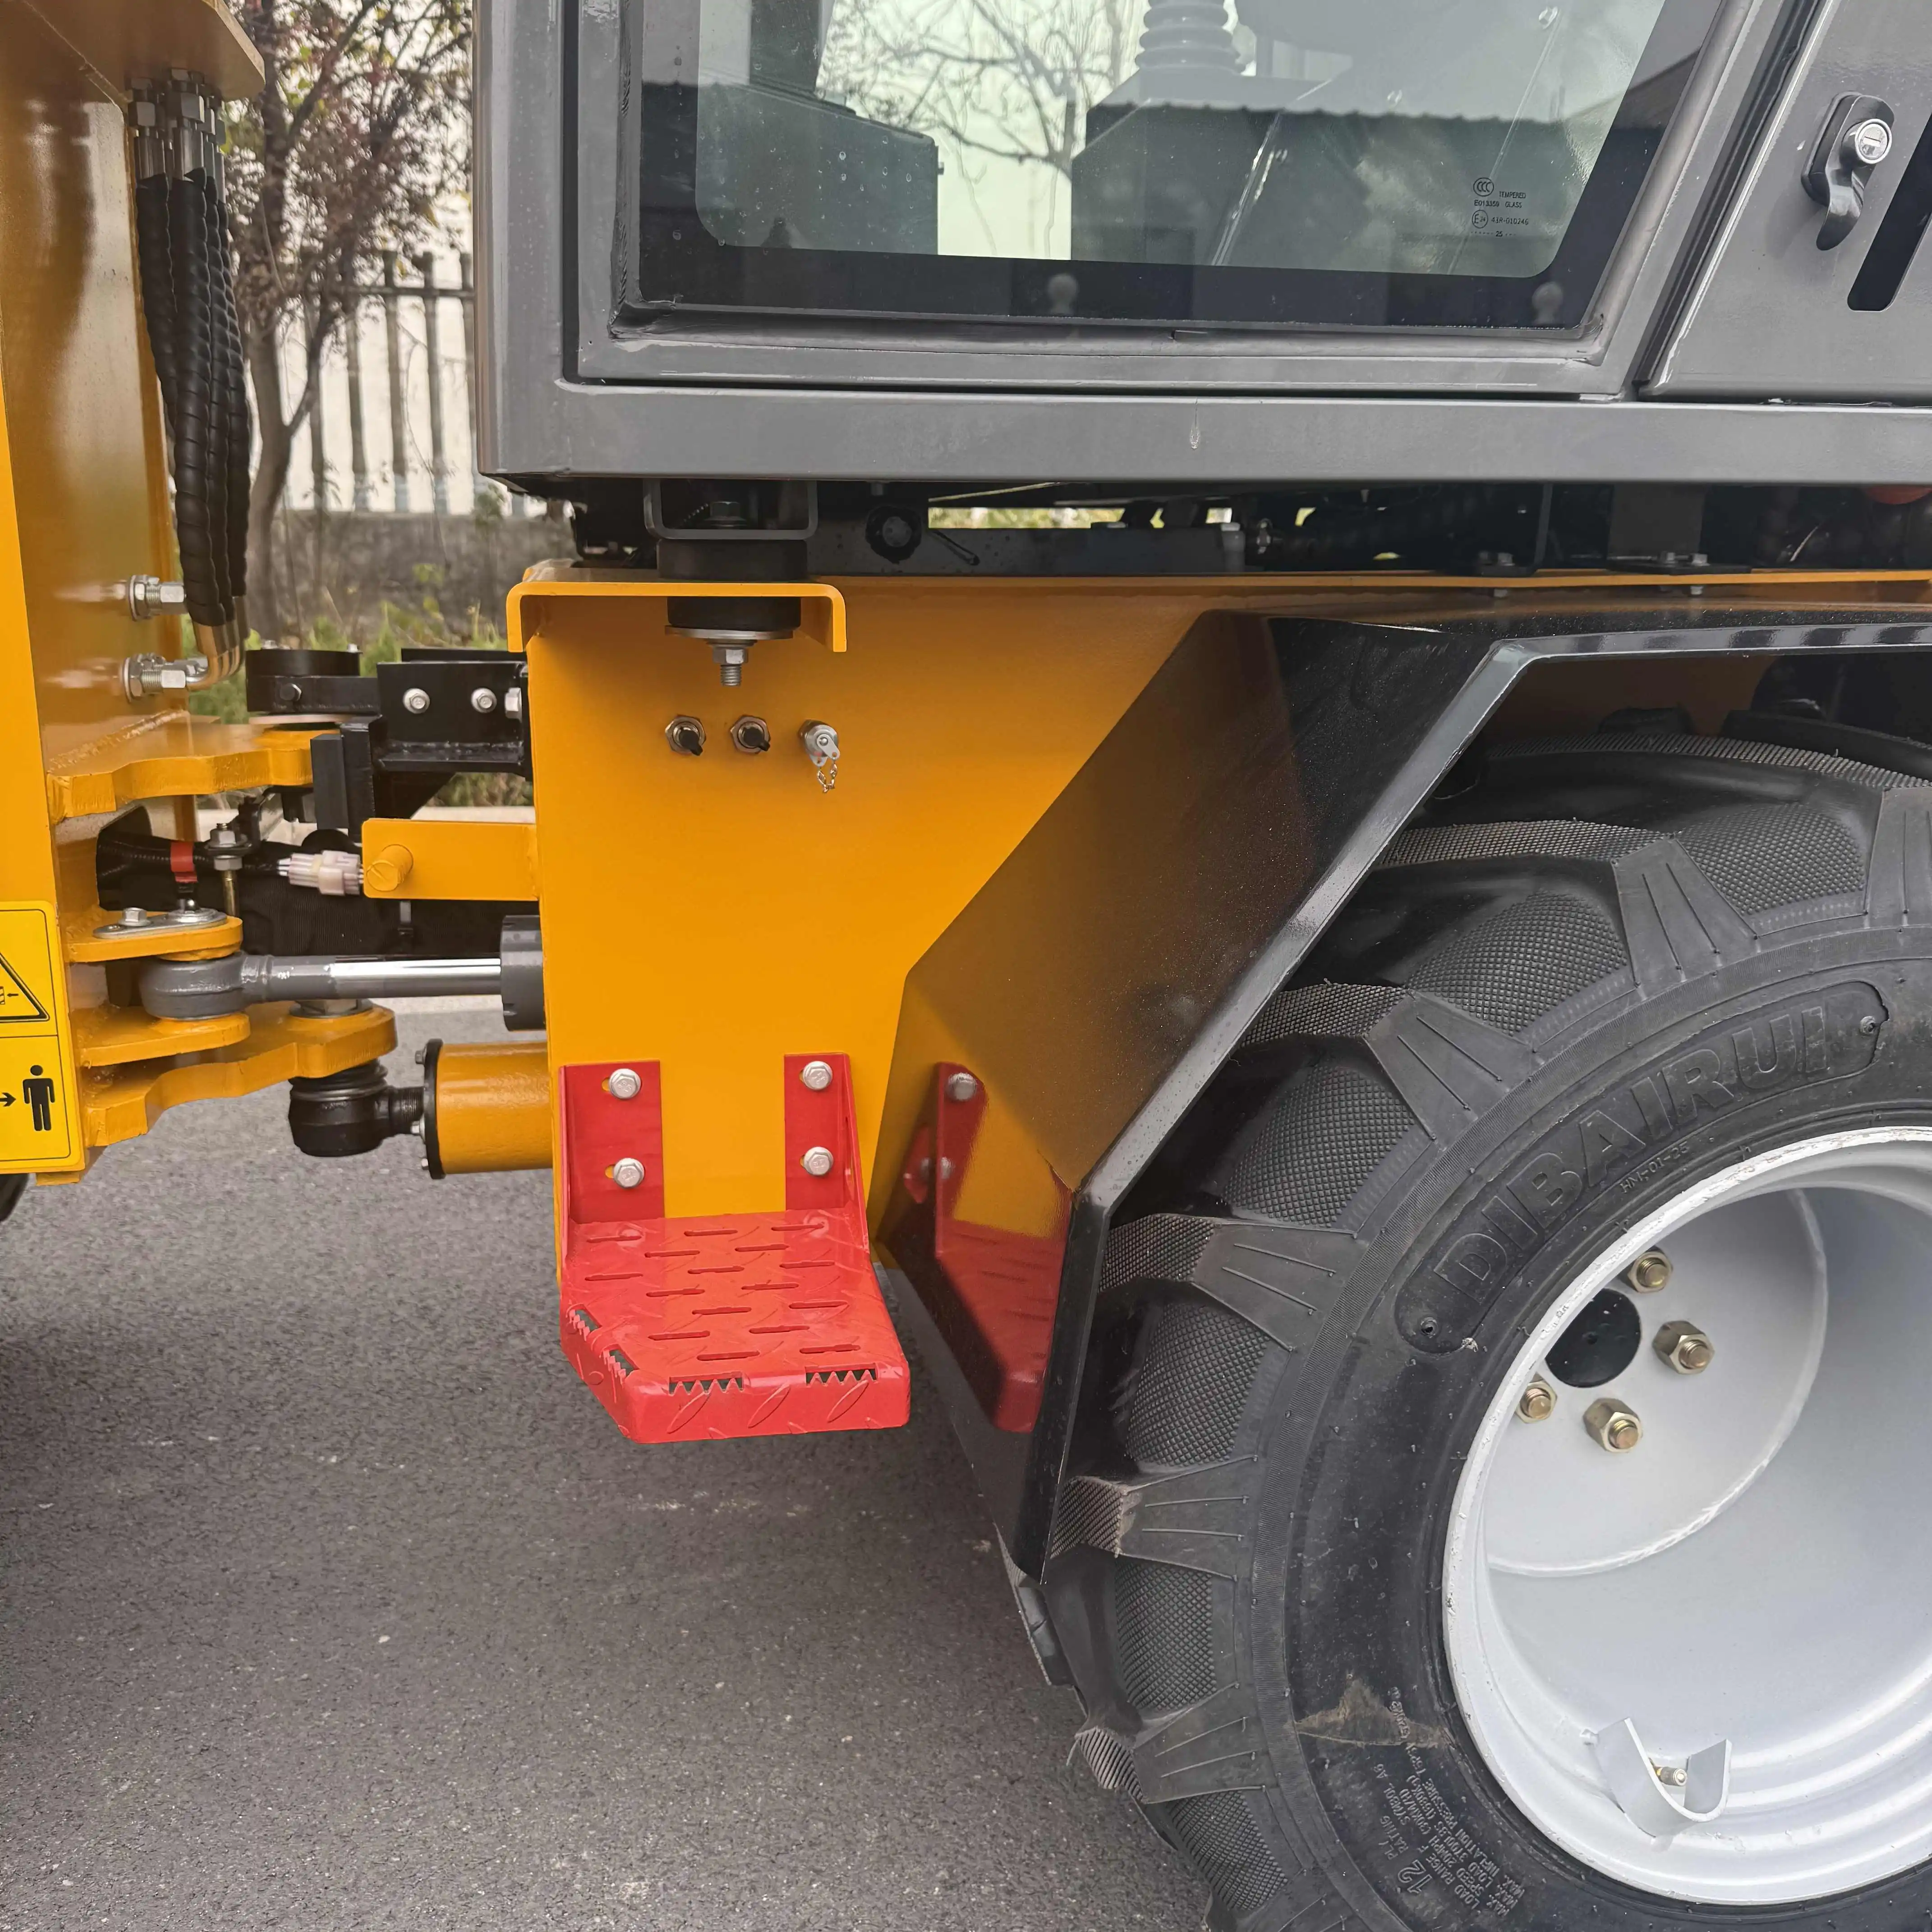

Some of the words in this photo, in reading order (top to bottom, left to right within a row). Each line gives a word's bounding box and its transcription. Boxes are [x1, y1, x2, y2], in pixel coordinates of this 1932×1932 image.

[1434, 1004, 1830, 1304] DIBAIRUI
[1421, 1777, 1458, 1829] PRESSURE
[1379, 1815, 1409, 1854] RATING
[1378, 1841, 1398, 1860] PLY
[1428, 1835, 1457, 1868] 20MPH
[1454, 1828, 1500, 1877] INFLATION
[1398, 1858, 1433, 1891] 12
[1425, 1852, 1456, 1885] RANGE
[1455, 1867, 1485, 1897] SPEED
[1467, 1862, 1494, 1888] LOAD
[1453, 1882, 1480, 1909] LOAD
[1494, 1885, 1518, 1909] MAX.
[1501, 1875, 1525, 1899] MAX.
[1486, 1895, 1509, 1918] MAX.
